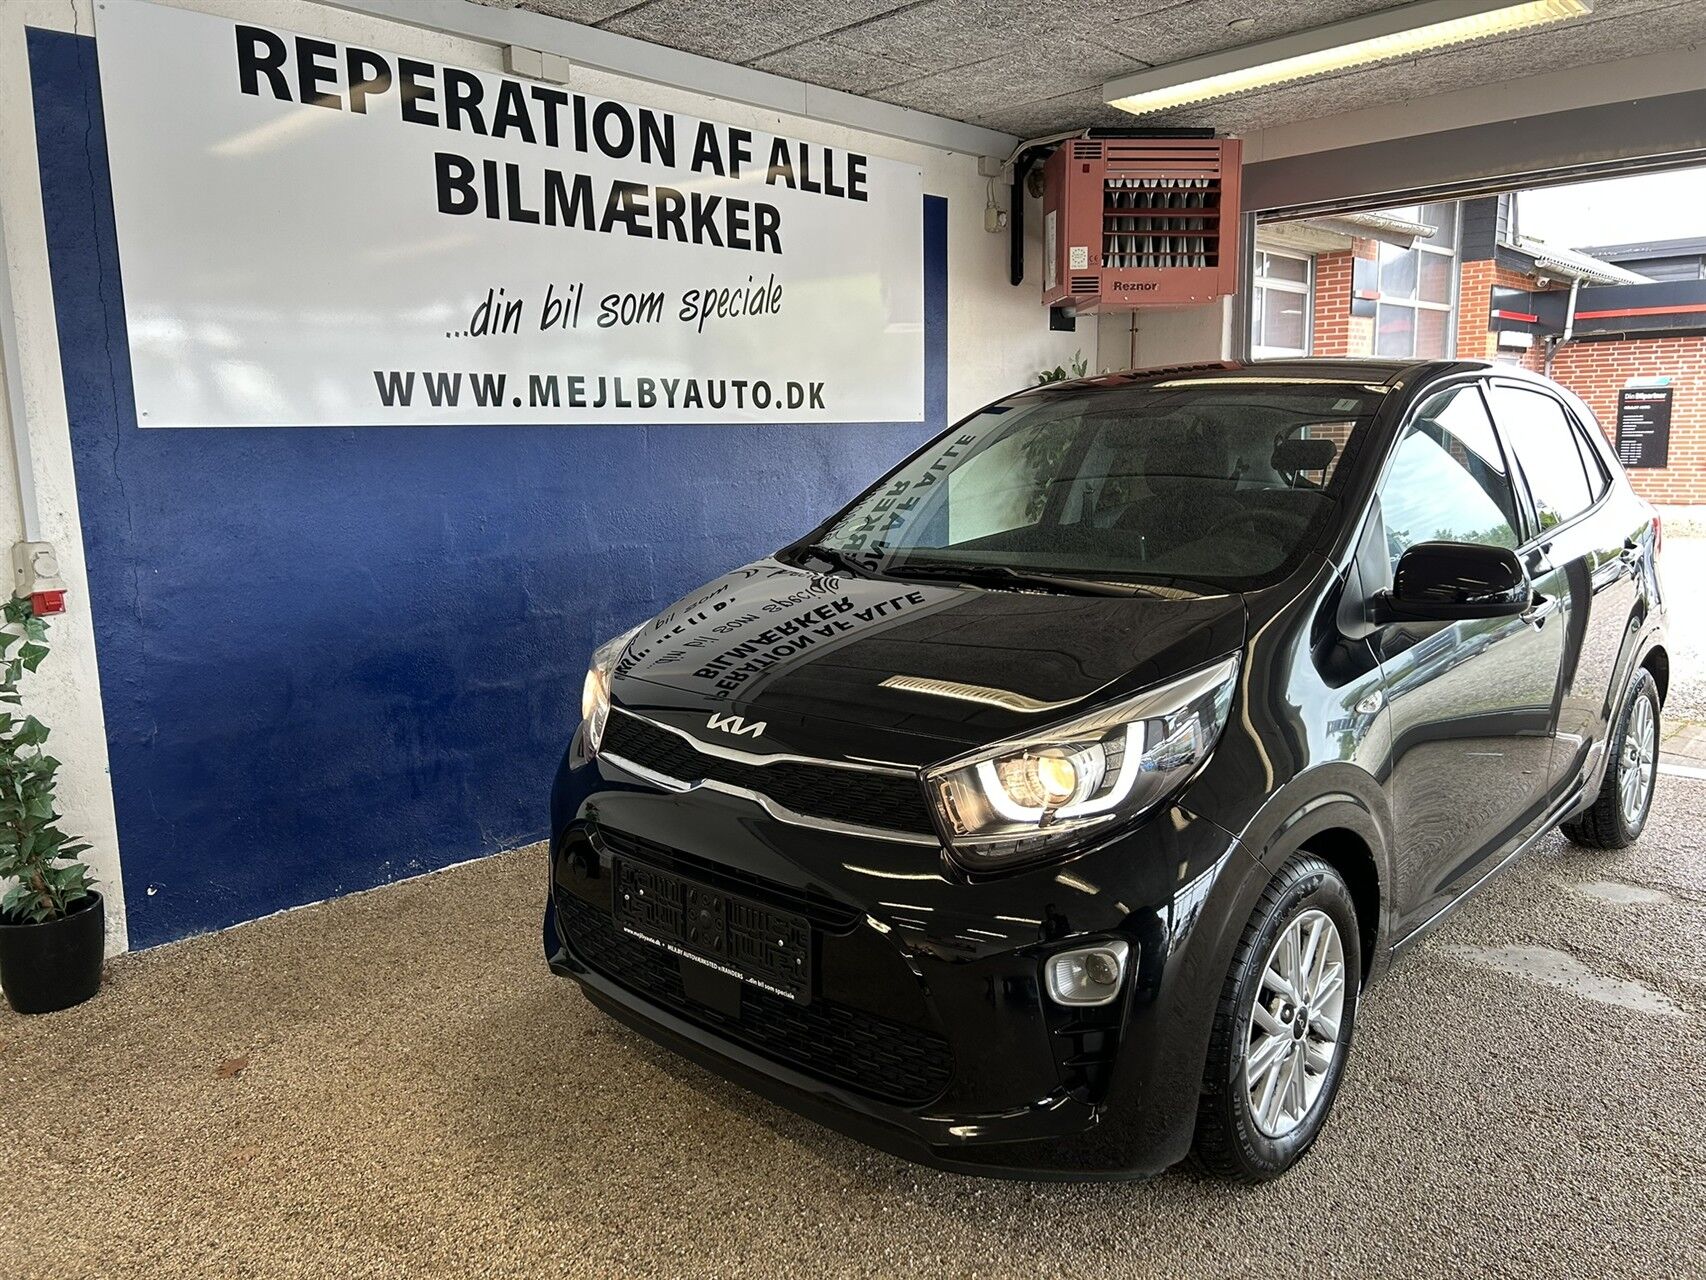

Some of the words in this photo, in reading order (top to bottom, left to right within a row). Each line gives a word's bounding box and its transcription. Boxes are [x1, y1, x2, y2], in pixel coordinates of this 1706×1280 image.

[234, 24, 676, 169] REPERATION
[691, 121, 753, 180] AF
[766, 138, 869, 203] ALLE
[434, 152, 783, 255] BILMÆRKER
[445, 287, 523, 339] ...din
[540, 282, 584, 332] bil
[597, 292, 663, 328] som
[679, 273, 783, 335] speciale
[1113, 280, 1158, 292] Reznor
[373, 369, 826, 410] WWW.MEJLBYAUTO.DK
